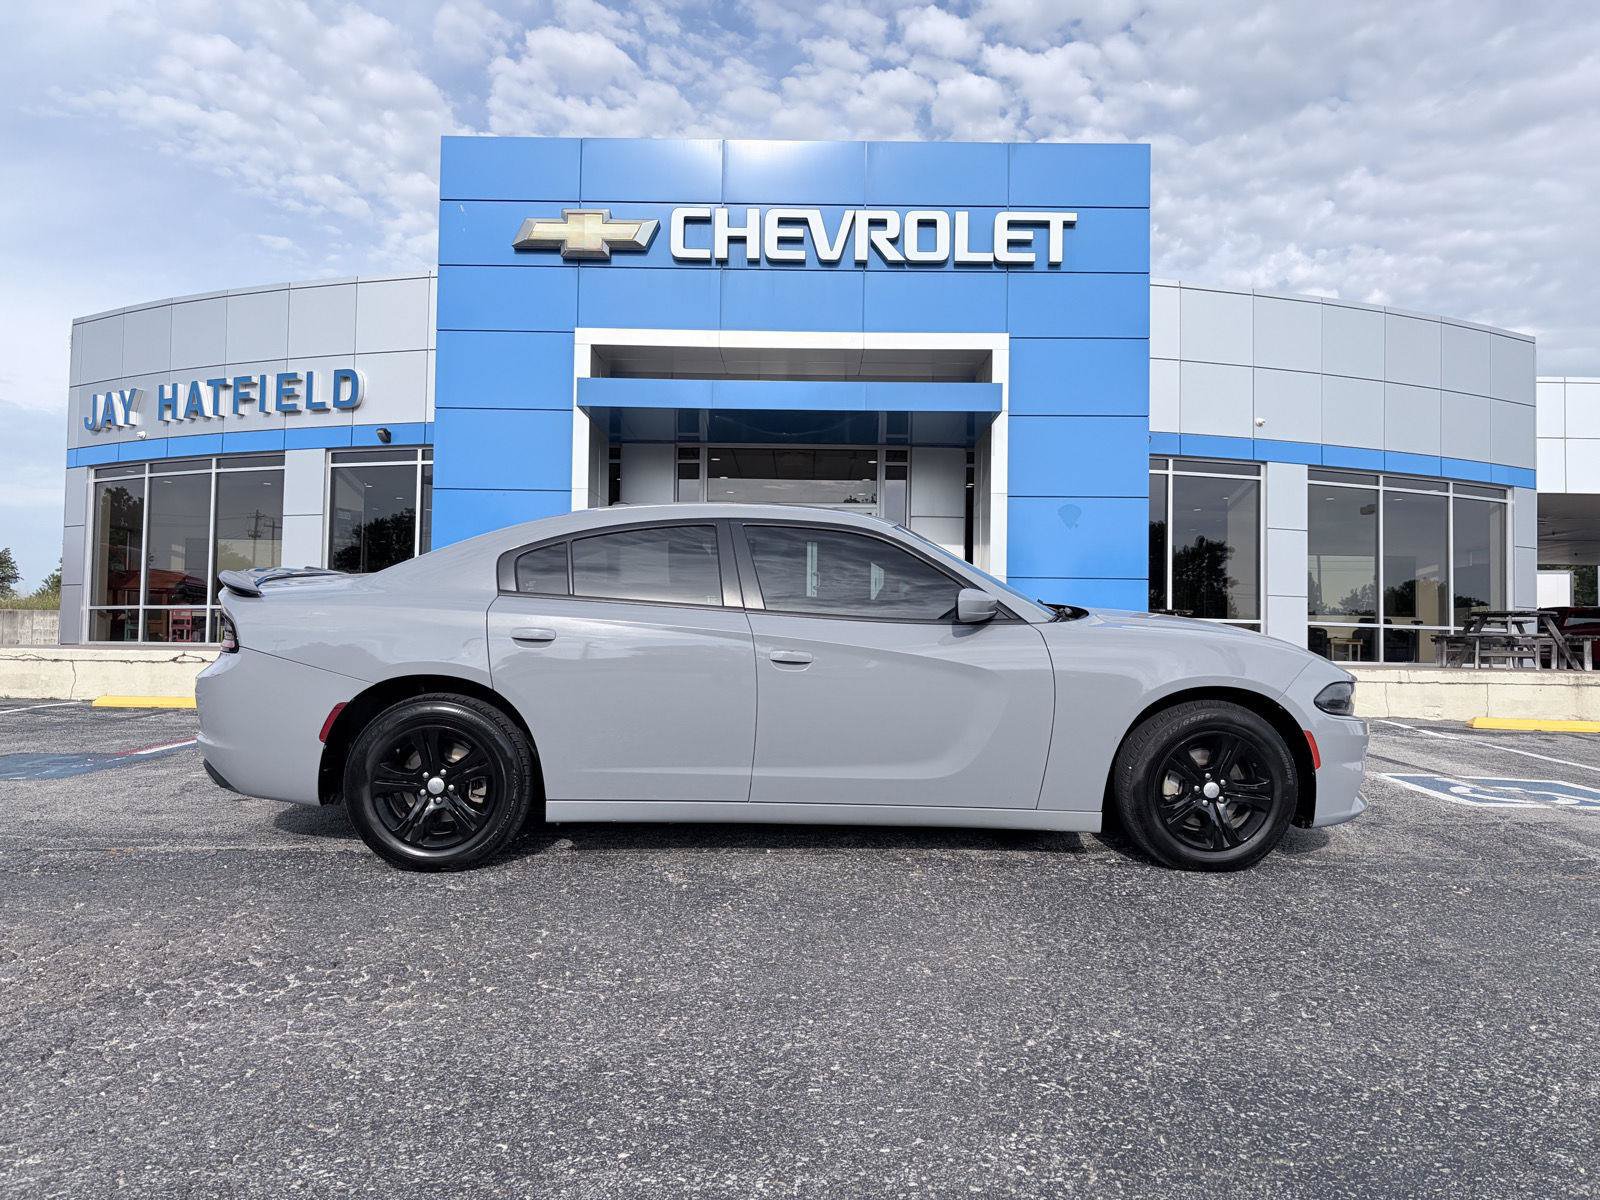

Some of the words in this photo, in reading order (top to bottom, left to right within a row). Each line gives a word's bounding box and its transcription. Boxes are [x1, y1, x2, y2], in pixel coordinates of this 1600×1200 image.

[670, 206, 1078, 266] CHEVROLET
[84, 387, 141, 432] JAY
[158, 368, 363, 422] HATFIELD
